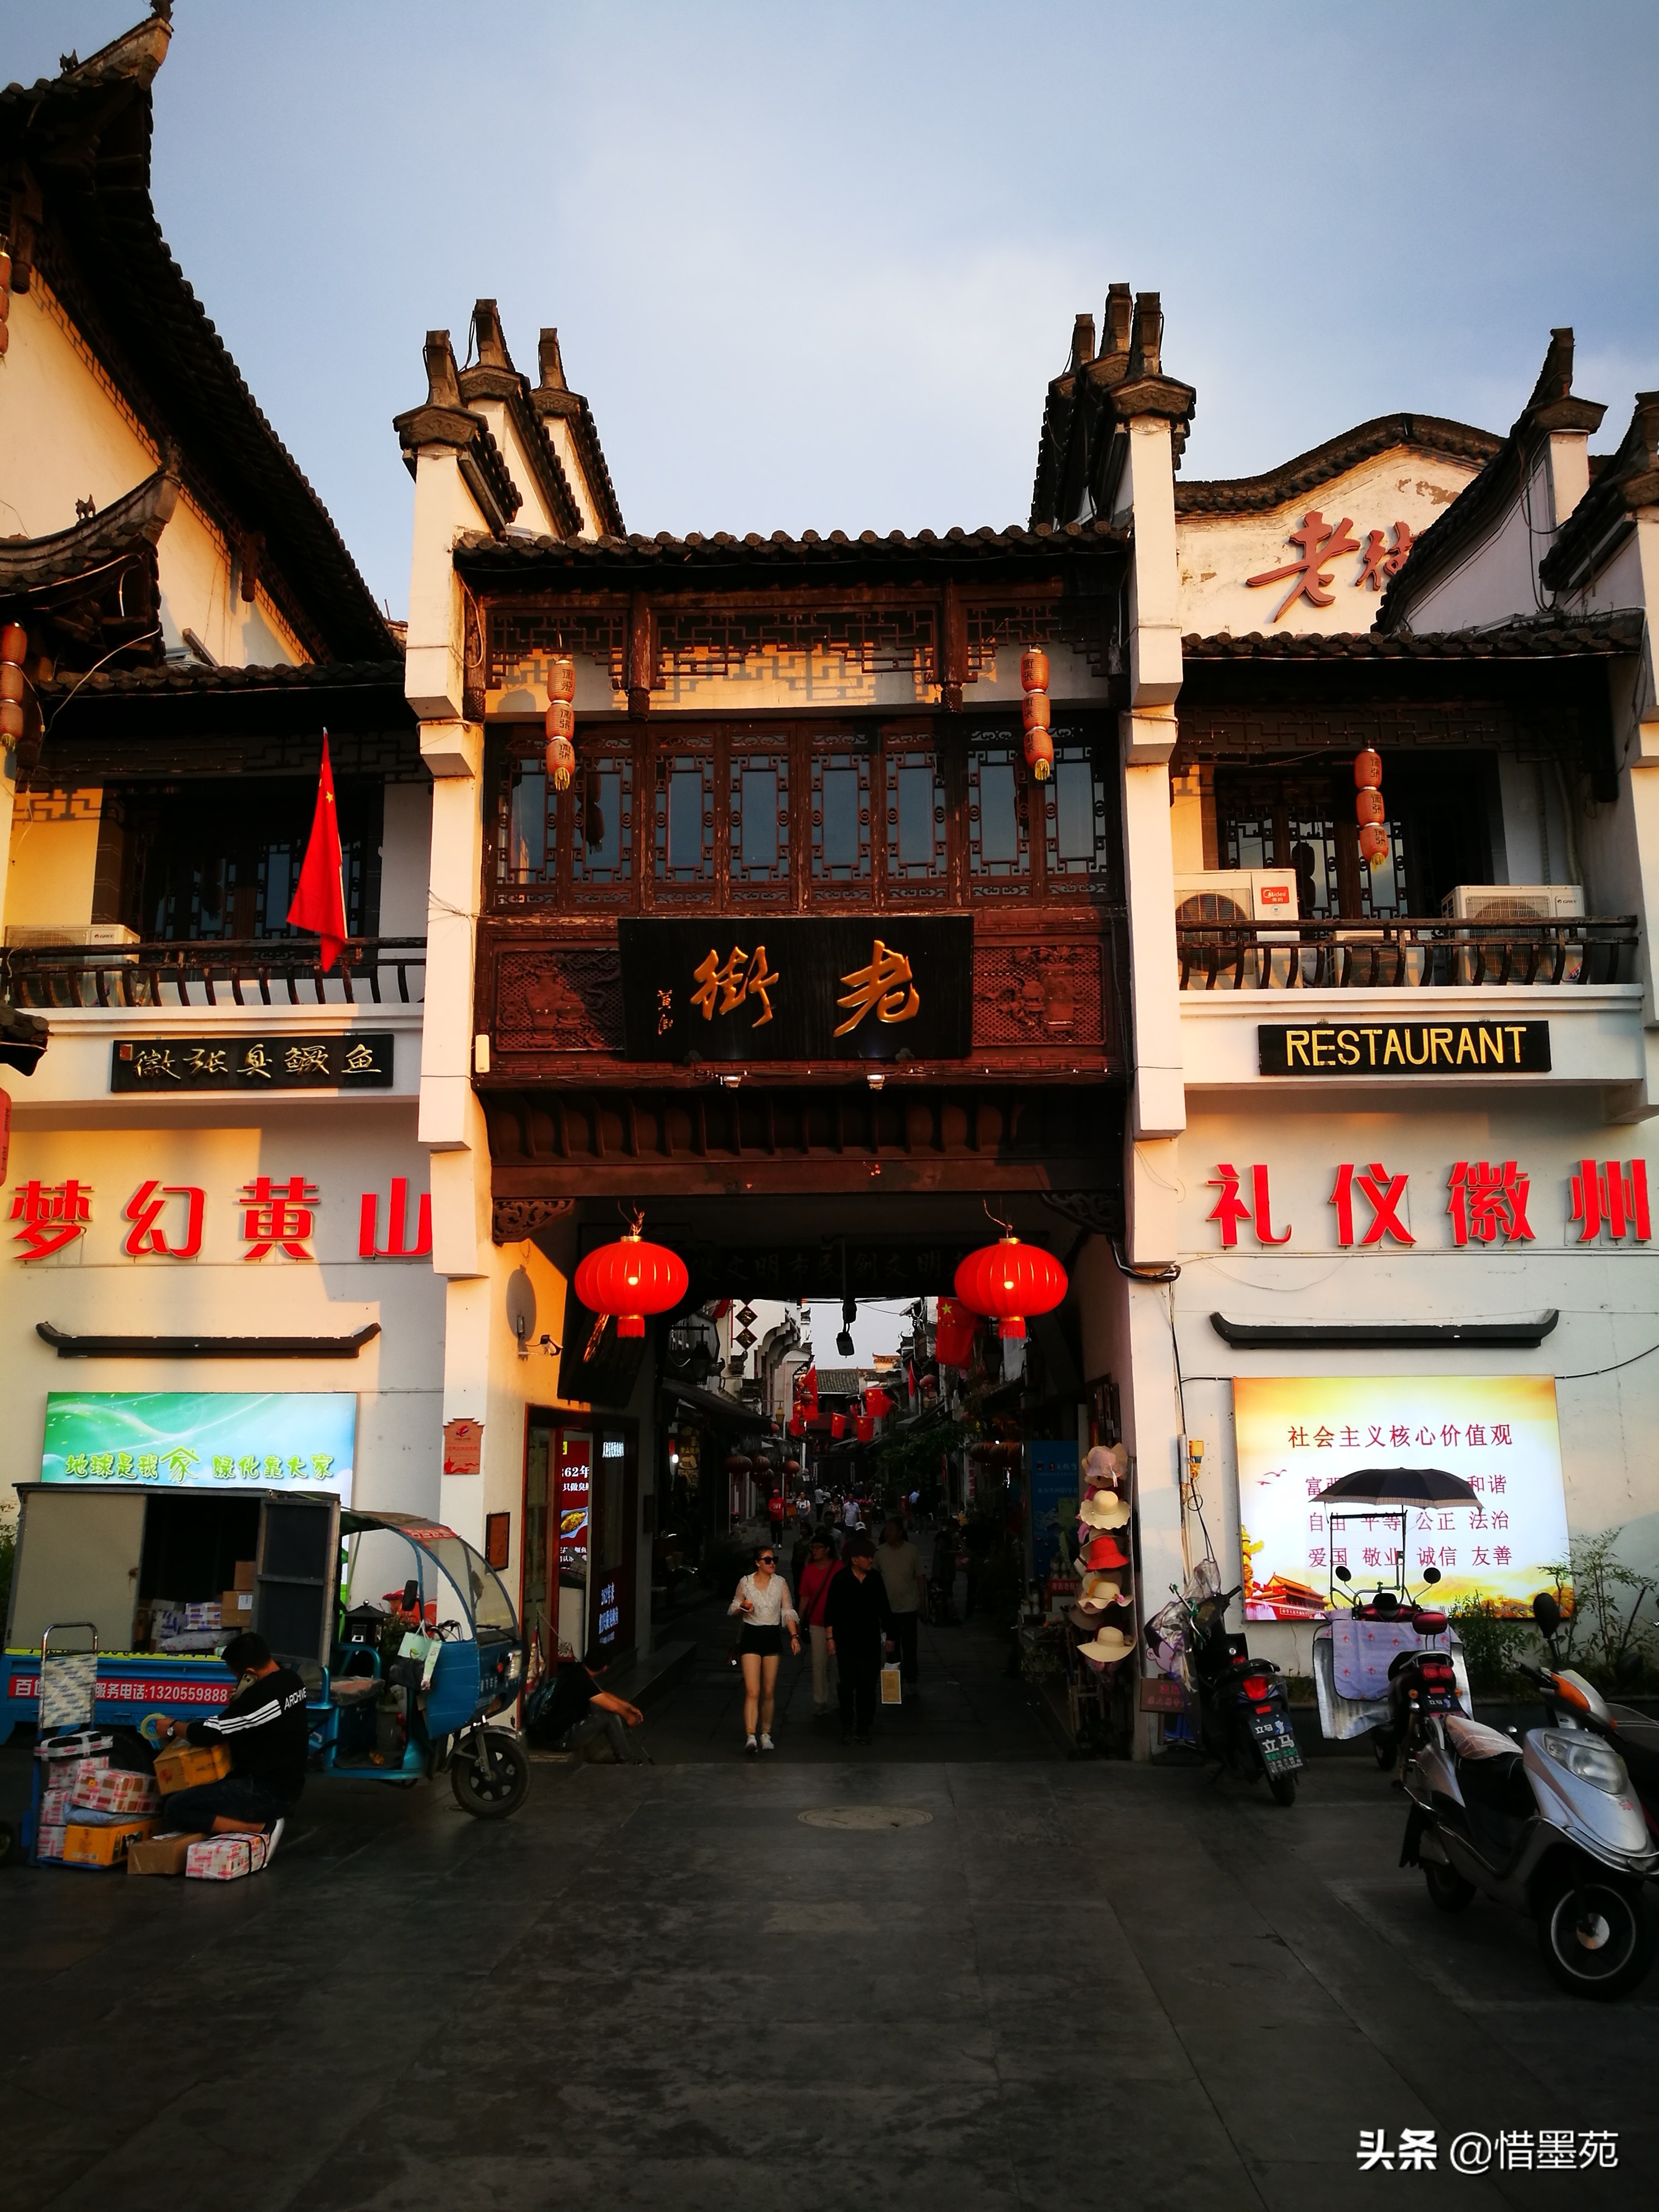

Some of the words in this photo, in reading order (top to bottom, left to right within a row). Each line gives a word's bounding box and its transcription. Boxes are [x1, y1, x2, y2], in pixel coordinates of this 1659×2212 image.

[690, 940, 920, 1037] 老街
[1286, 1027, 1526, 1066] RESTAURANT
[1206, 1158, 1652, 1246] 礼仪徽州
[9, 1176, 432, 1260] 梦幻黄山
[1288, 1423, 1513, 1448] 社会主义核心价值观
[65, 1446, 201, 1484] 地球是我家
[1309, 1513, 1346, 1532] 自由
[1417, 1511, 1456, 1531] 公正
[1469, 1510, 1509, 1530] 法治
[1308, 1548, 1348, 1568] 爱国
[1417, 1546, 1457, 1567] 诚信
[1472, 1545, 1512, 1566] 友善
[284, 1687, 307, 1710] ARCHIVE
[1255, 1724, 1273, 1734] 立马
[1262, 1734, 1295, 1754] 立马
